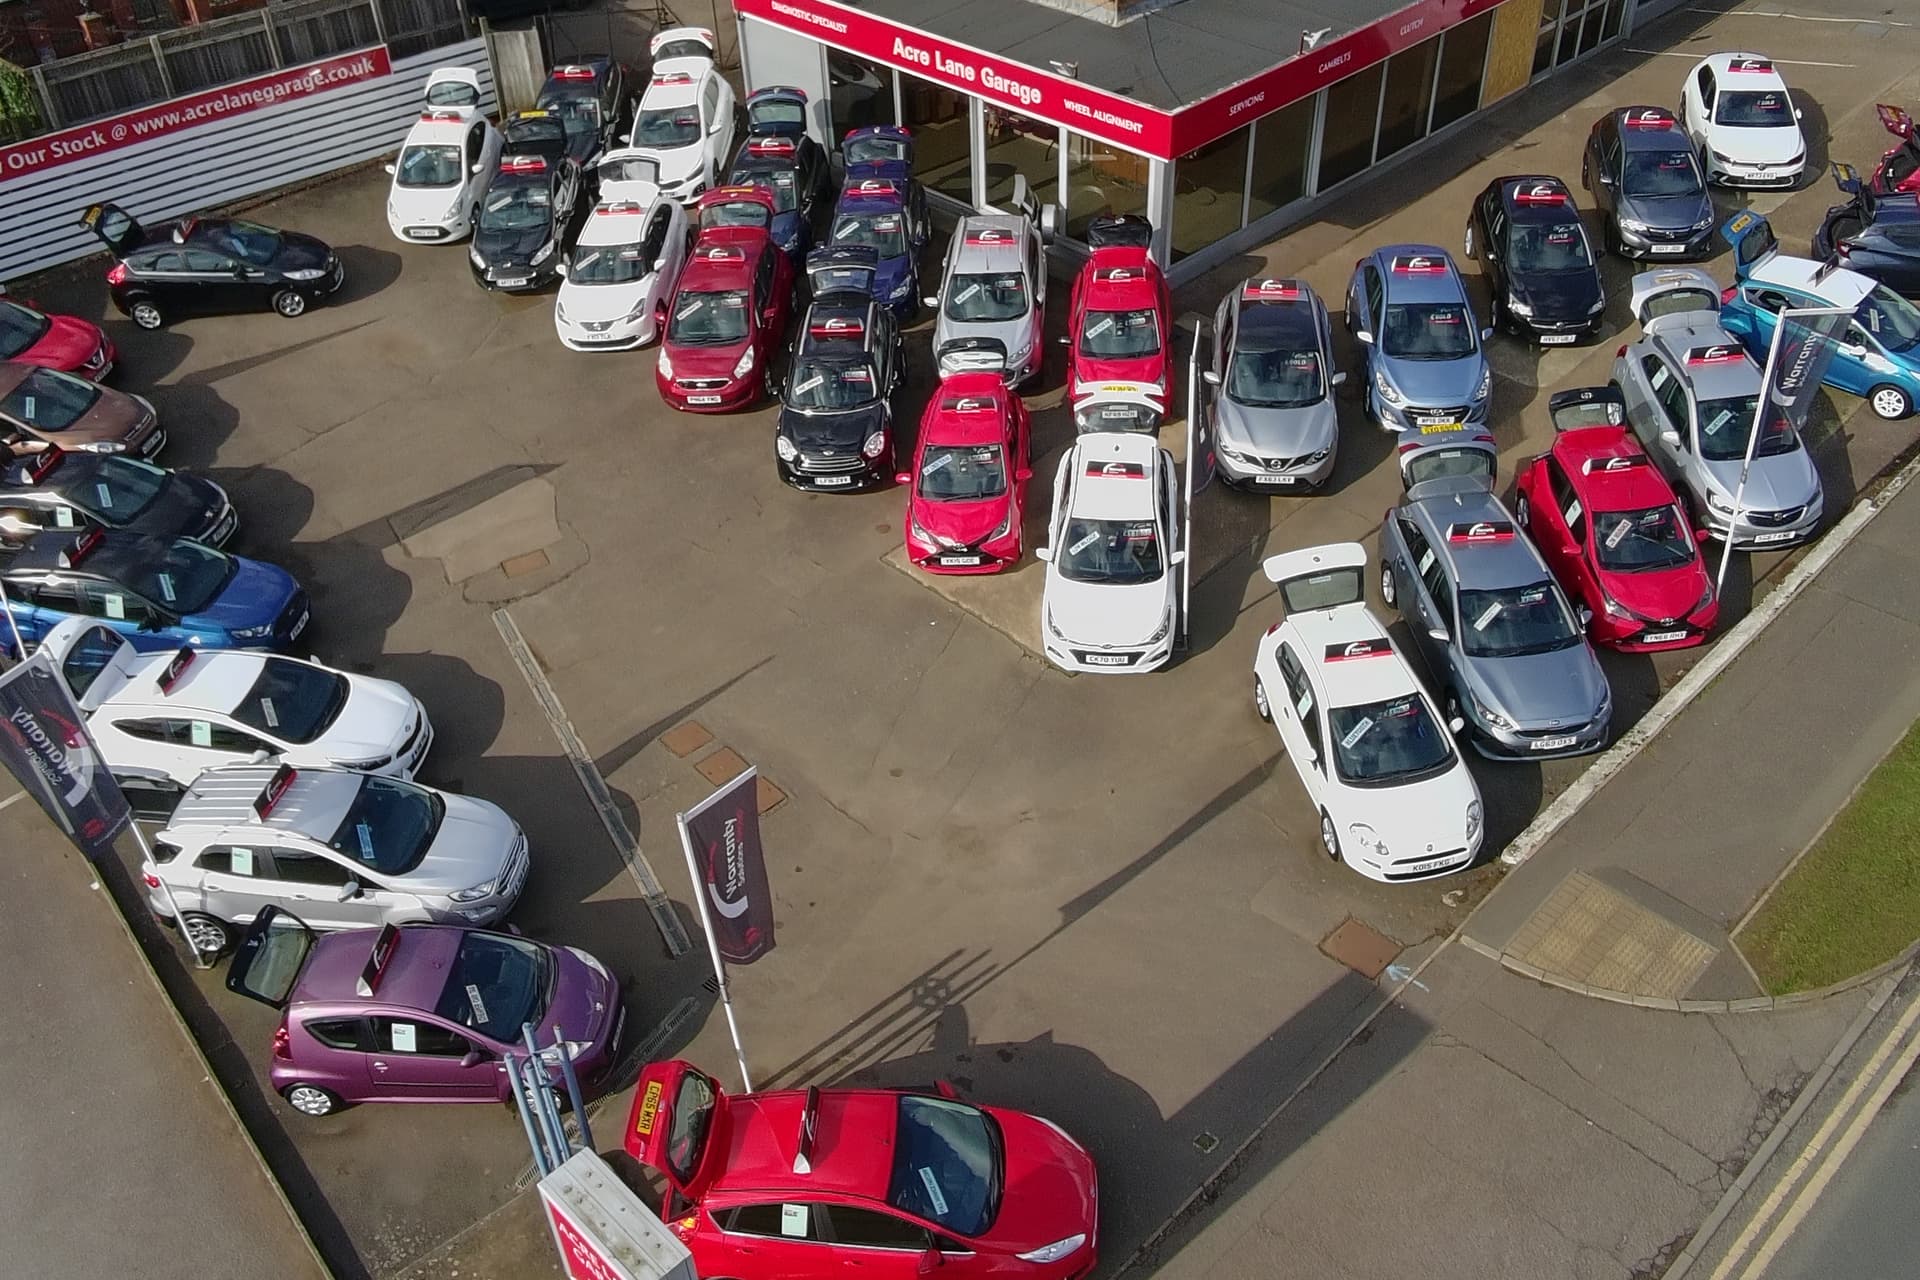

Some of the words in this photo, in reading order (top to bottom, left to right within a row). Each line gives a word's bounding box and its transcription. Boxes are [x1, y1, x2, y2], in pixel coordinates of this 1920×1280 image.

[811, 14, 848, 33] SPECIALIST
[1400, 17, 1424, 36] CLUTCH
[892, 37, 930, 66] Acre
[934, 50, 976, 81] Lane
[981, 67, 1042, 105] Garage
[1318, 50, 1352, 74] CAMBELTS
[7, 149, 46, 169] Our
[50, 130, 107, 158] Stock
[111, 124, 127, 141] @
[132, 57, 375, 135] www.acrelanegarage.co.uk
[1063, 99, 1092, 118] WHEEL
[1093, 110, 1143, 134] ALIGNMENT
[1228, 91, 1265, 116] SERVICING
[1780, 330, 1819, 390] Warranty
[722, 817, 738, 900] Warranty
[736, 841, 746, 888] Solutions
[645, 1085, 660, 1110] CP65
[640, 1109, 655, 1130] WXR
[559, 1222, 601, 1270] ACRE
